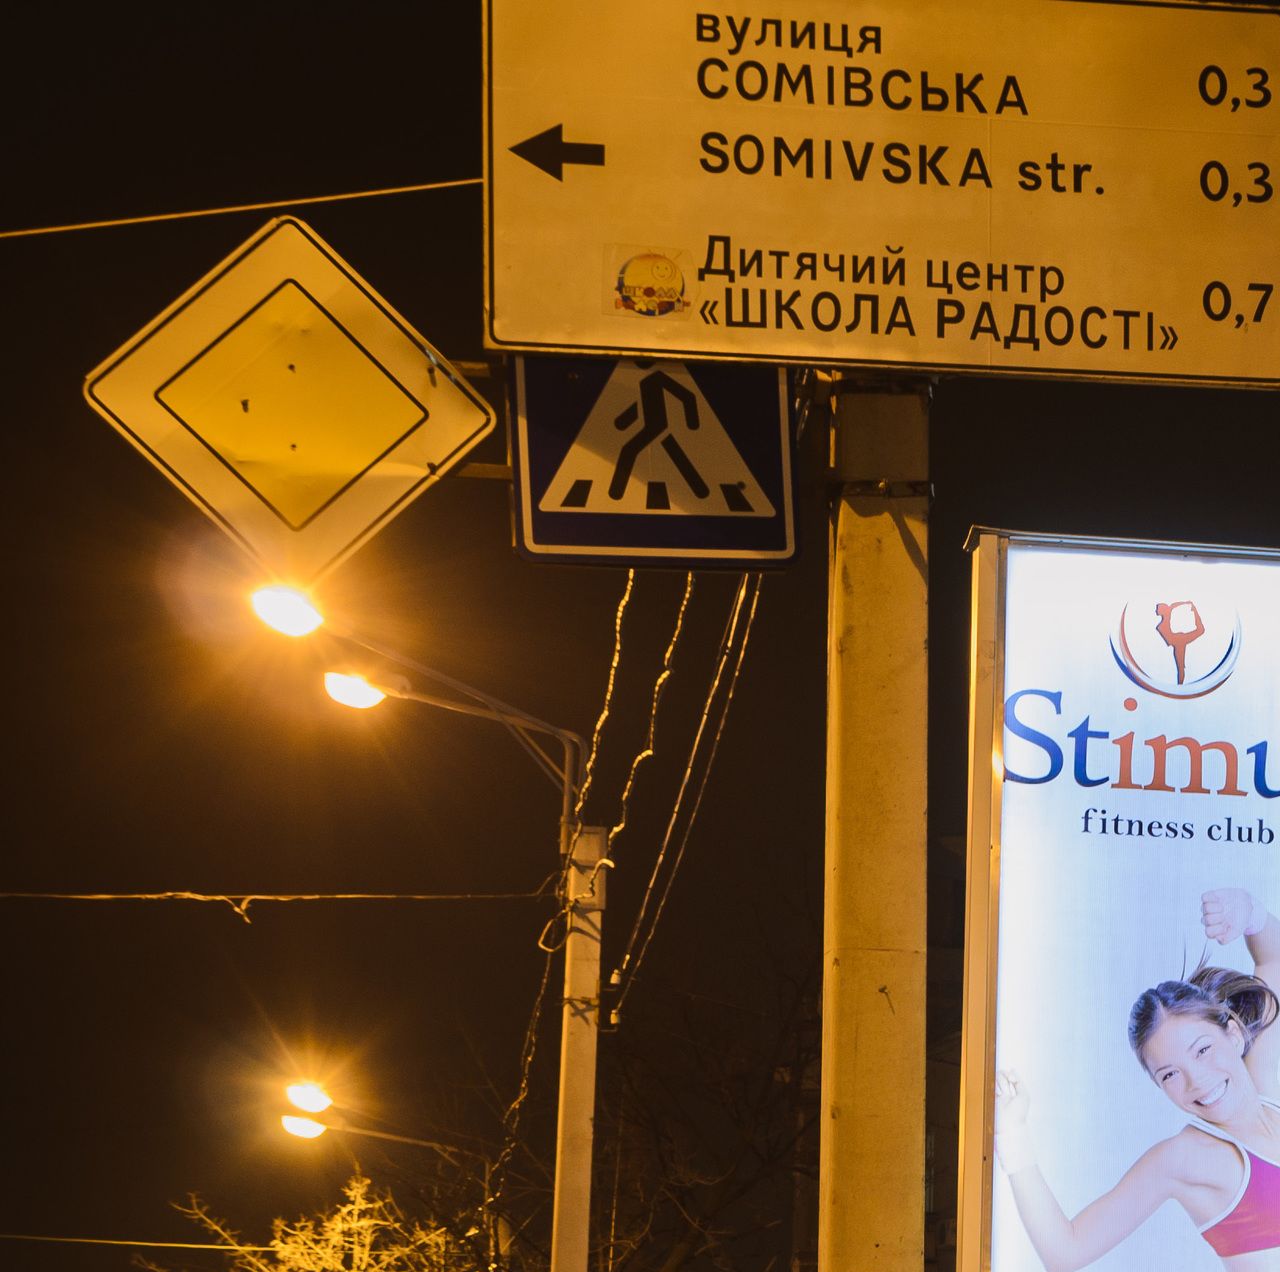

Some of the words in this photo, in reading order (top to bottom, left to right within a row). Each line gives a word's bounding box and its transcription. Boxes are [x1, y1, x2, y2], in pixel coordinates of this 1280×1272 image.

[695, 11, 882, 57] вулиця
[695, 57, 1029, 116] СОМІВСЬКА
[1198, 64, 1273, 114] 0,3
[698, 131, 993, 190] SOMIVSKA
[1018, 152, 1106, 196] str.
[1199, 159, 1275, 207] 0,3
[698, 234, 908, 288] Дитячий
[925, 257, 1065, 301] центр
[698, 289, 917, 339] «ШКОЛА
[936, 299, 1179, 353] РАДОСТІ»
[1201, 280, 1275, 332] 0,7
[1081, 808, 1195, 839] fitness
[1206, 817, 1276, 844] club
